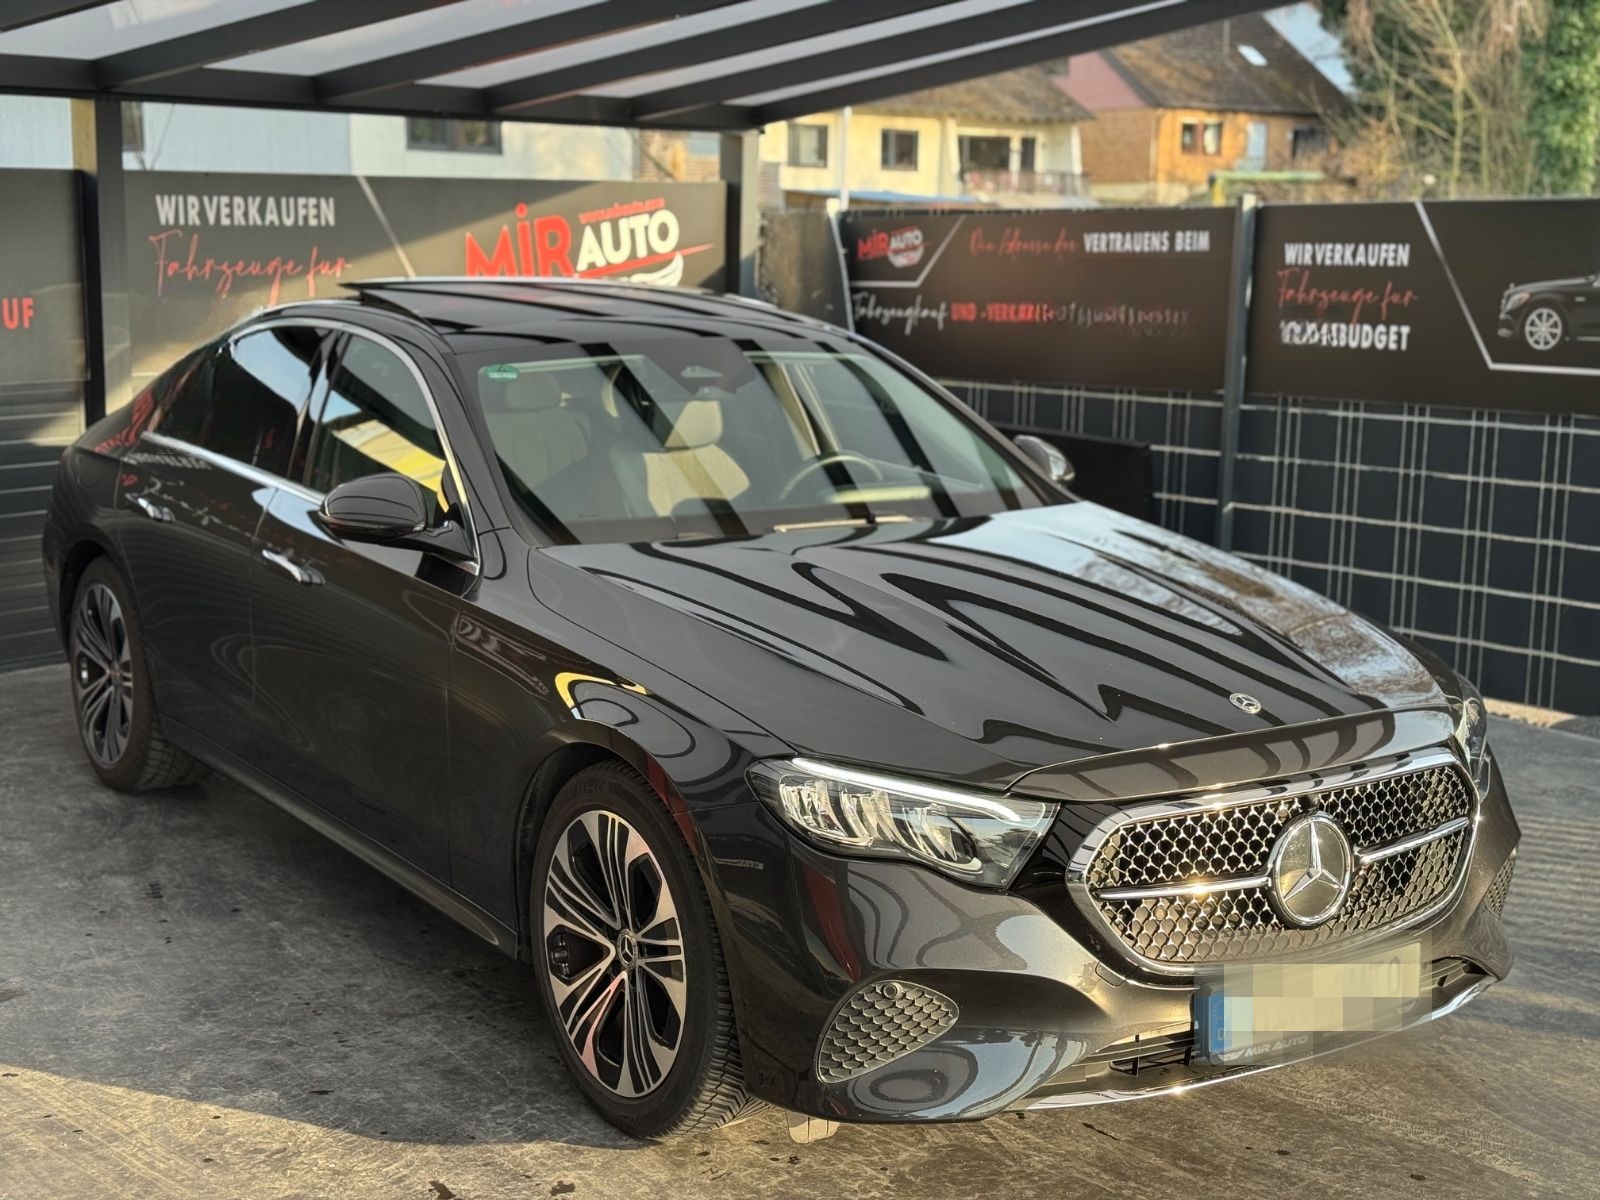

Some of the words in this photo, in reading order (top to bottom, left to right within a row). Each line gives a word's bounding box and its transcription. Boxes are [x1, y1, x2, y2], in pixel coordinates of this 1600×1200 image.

[155, 195, 200, 227] WIR
[201, 196, 335, 227] VERKAUFEN
[576, 209, 680, 272] AUTO
[1083, 231, 1169, 254] VERTRAUENS
[1174, 230, 1211, 252] BEIM
[1284, 243, 1313, 266] WIR
[1314, 243, 1411, 267] VERKAUFEN
[1339, 322, 1411, 351] BUDGET
[1272, 1035, 1309, 1051] AUTO
